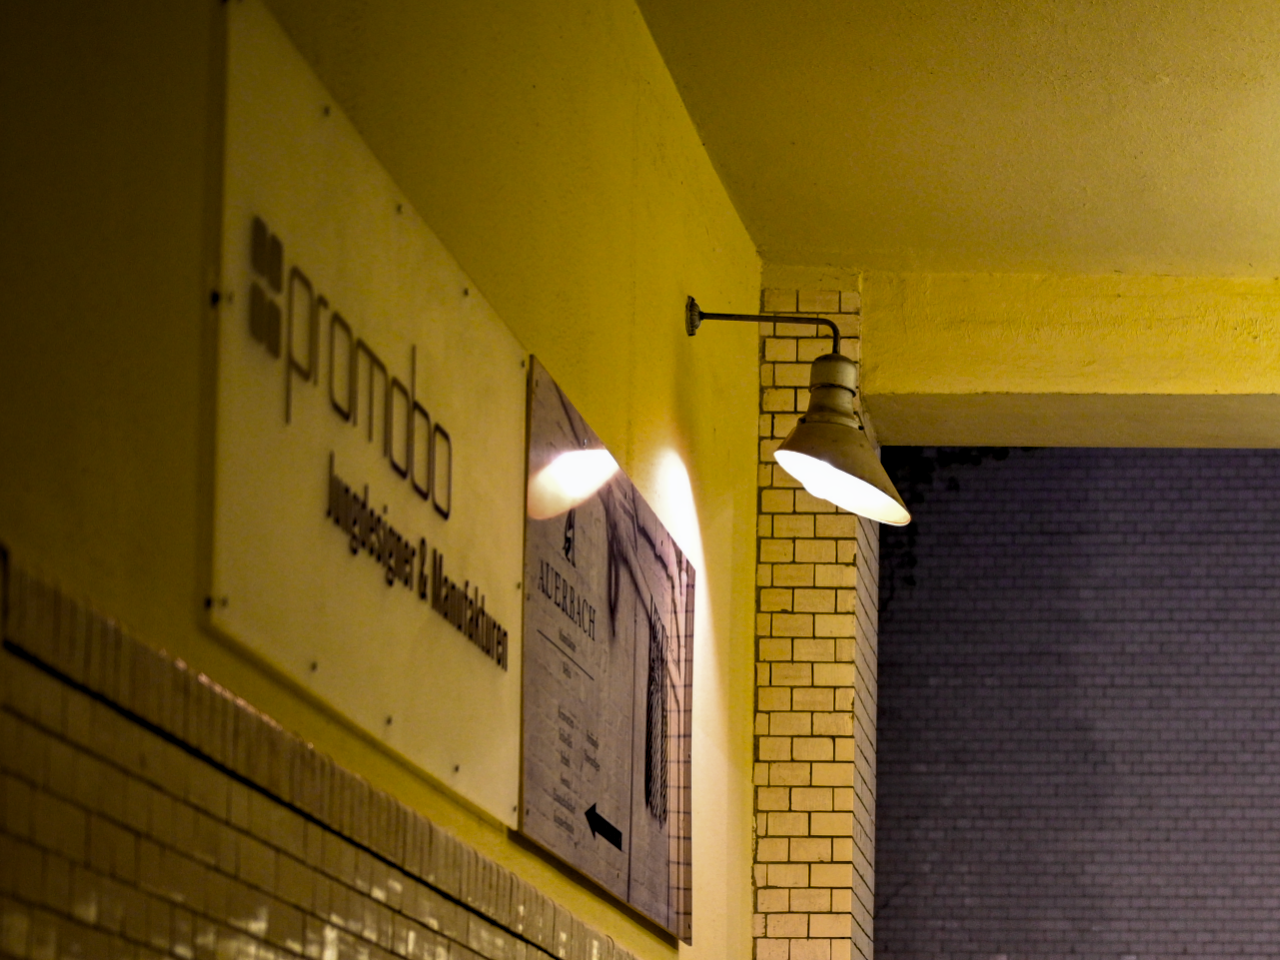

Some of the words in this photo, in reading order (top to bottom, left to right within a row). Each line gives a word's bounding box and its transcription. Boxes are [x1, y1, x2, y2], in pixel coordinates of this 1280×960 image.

[419, 536, 428, 600] &
[432, 547, 508, 672] Manufakturen
[538, 559, 596, 642] AUERBACH
